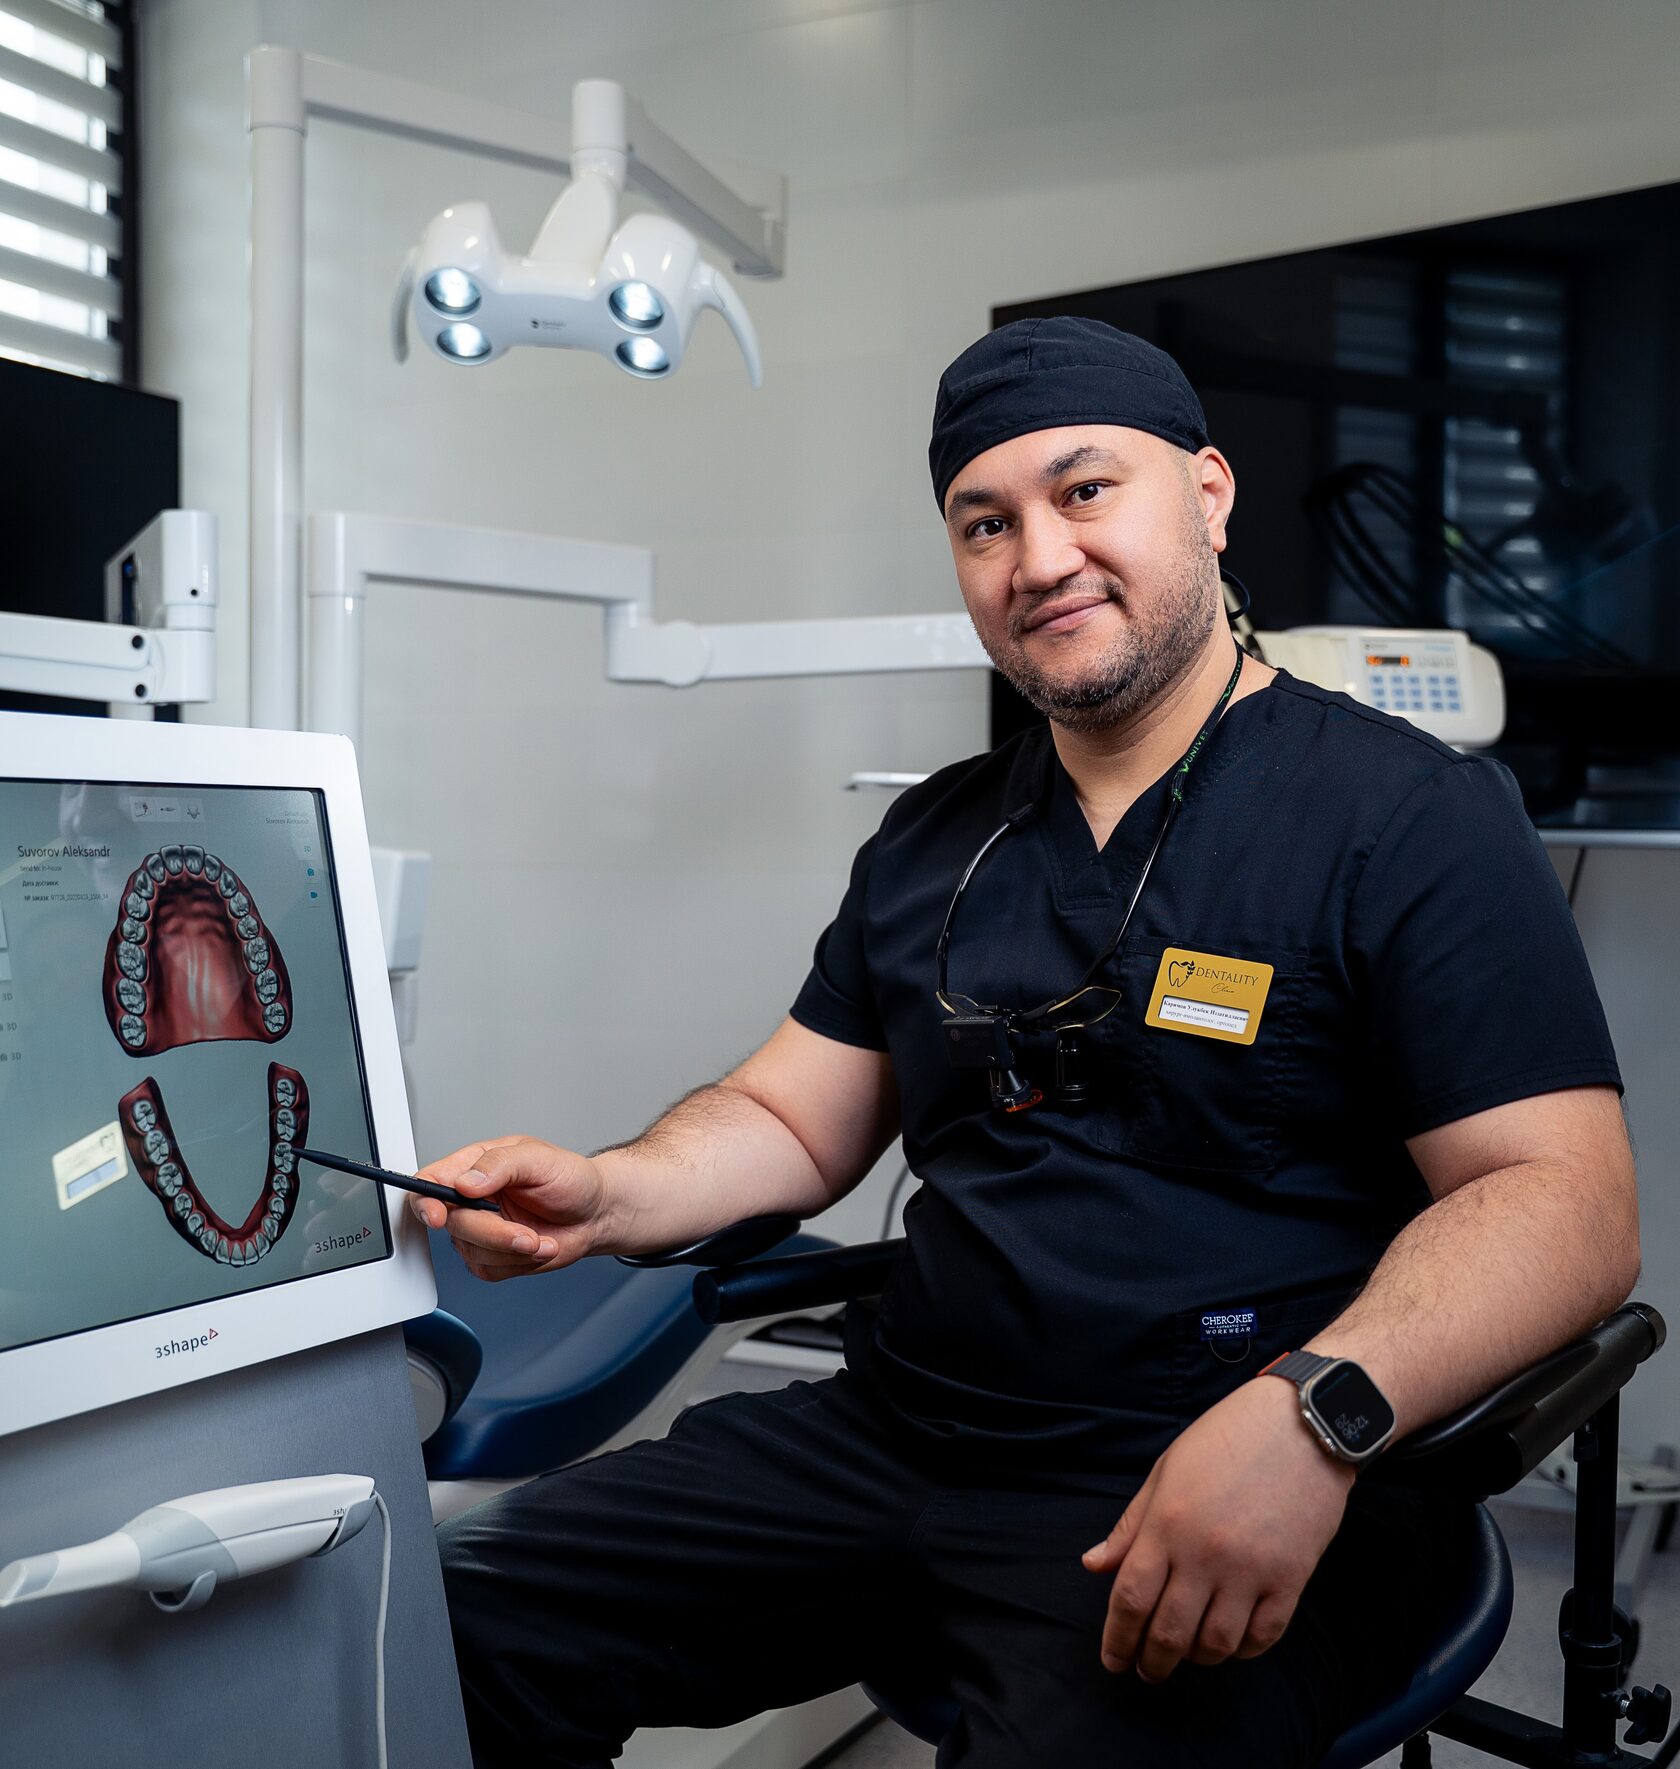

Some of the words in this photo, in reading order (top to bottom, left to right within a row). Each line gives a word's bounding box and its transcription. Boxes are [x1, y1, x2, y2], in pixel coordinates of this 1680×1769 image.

[17, 845, 60, 858] Suvorov
[62, 845, 111, 857] Aleksandr
[1195, 967, 1259, 986] DENTALITY
[315, 1232, 363, 1254] 3shape
[1201, 1313, 1254, 1326] CHEROKEE
[1205, 1326, 1251, 1335] WORKWEAR
[155, 1334, 209, 1359] 3shape
